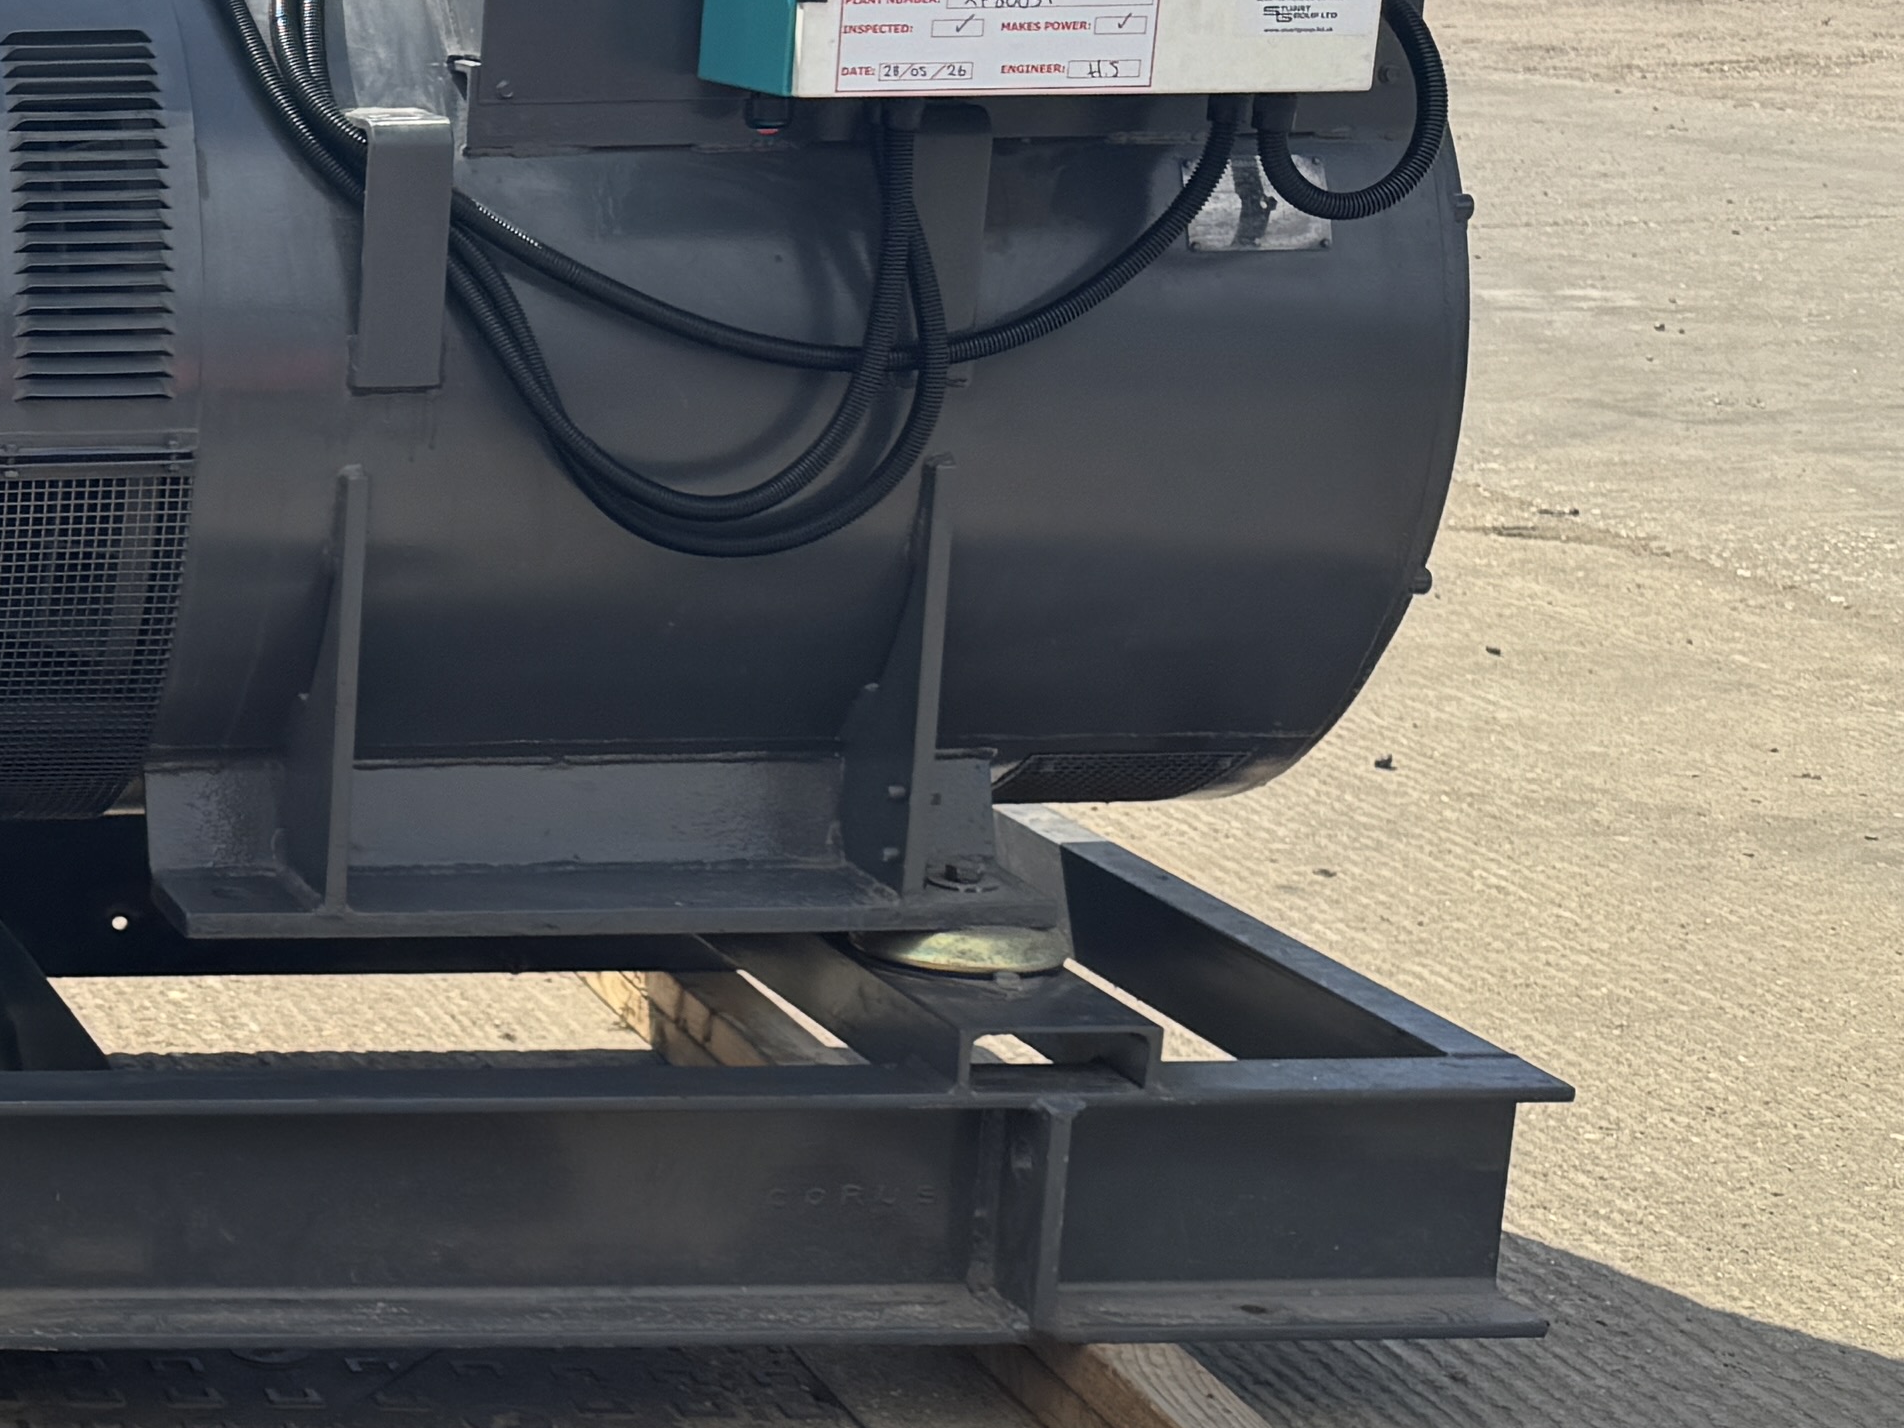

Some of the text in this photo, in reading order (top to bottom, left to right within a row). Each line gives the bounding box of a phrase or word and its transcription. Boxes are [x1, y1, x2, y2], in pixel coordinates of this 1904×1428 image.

[842, 23, 913, 34] INSPECTED:
[1001, 21, 1091, 32] MAKES POWER:
[841, 66, 875, 77] DATE:
[1001, 63, 1065, 74] ENGINEER:
